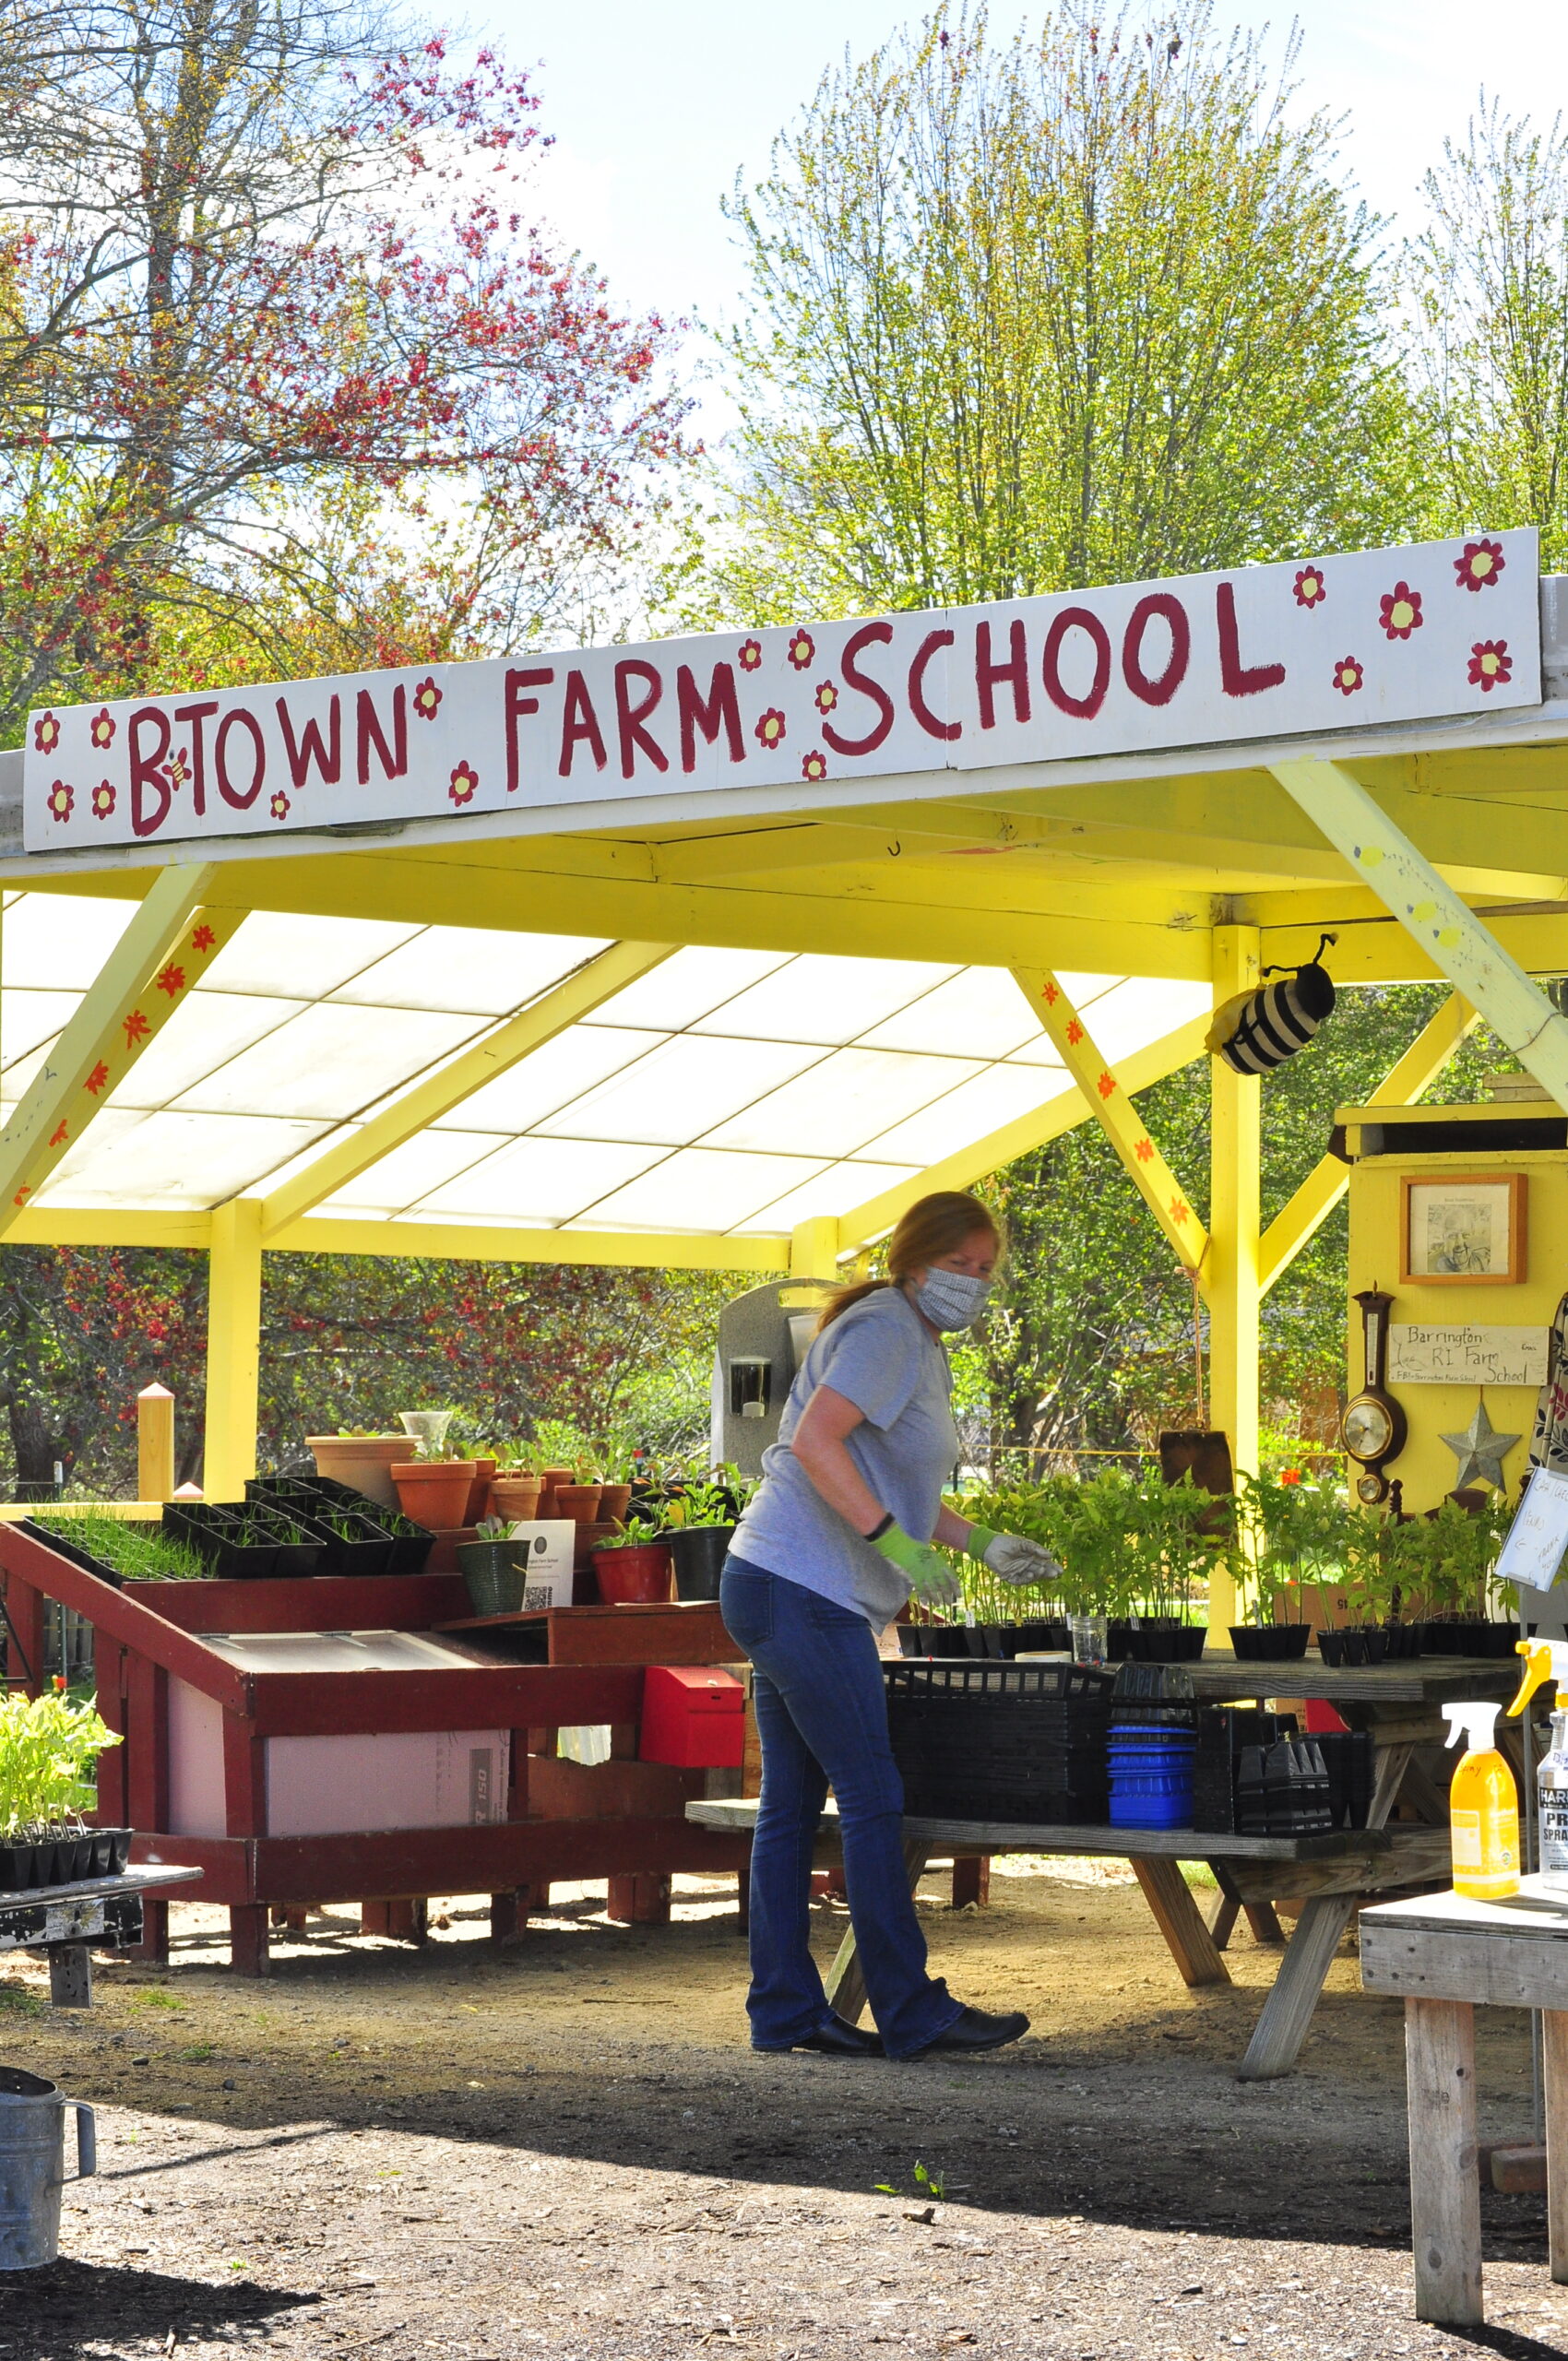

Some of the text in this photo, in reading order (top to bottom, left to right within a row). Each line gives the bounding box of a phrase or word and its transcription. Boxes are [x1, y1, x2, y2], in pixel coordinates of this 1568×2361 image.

[130, 582, 1286, 836] BTOWN FARM SCHOOL
[1408, 1326, 1482, 1347] Barrington
[1432, 1345, 1498, 1366] RI Farm
[1484, 1362, 1527, 1383] School
[479, 1770, 487, 1800] 150
[1540, 1790, 1568, 1804] HAR
[1544, 1829, 1568, 1841] SPRA
